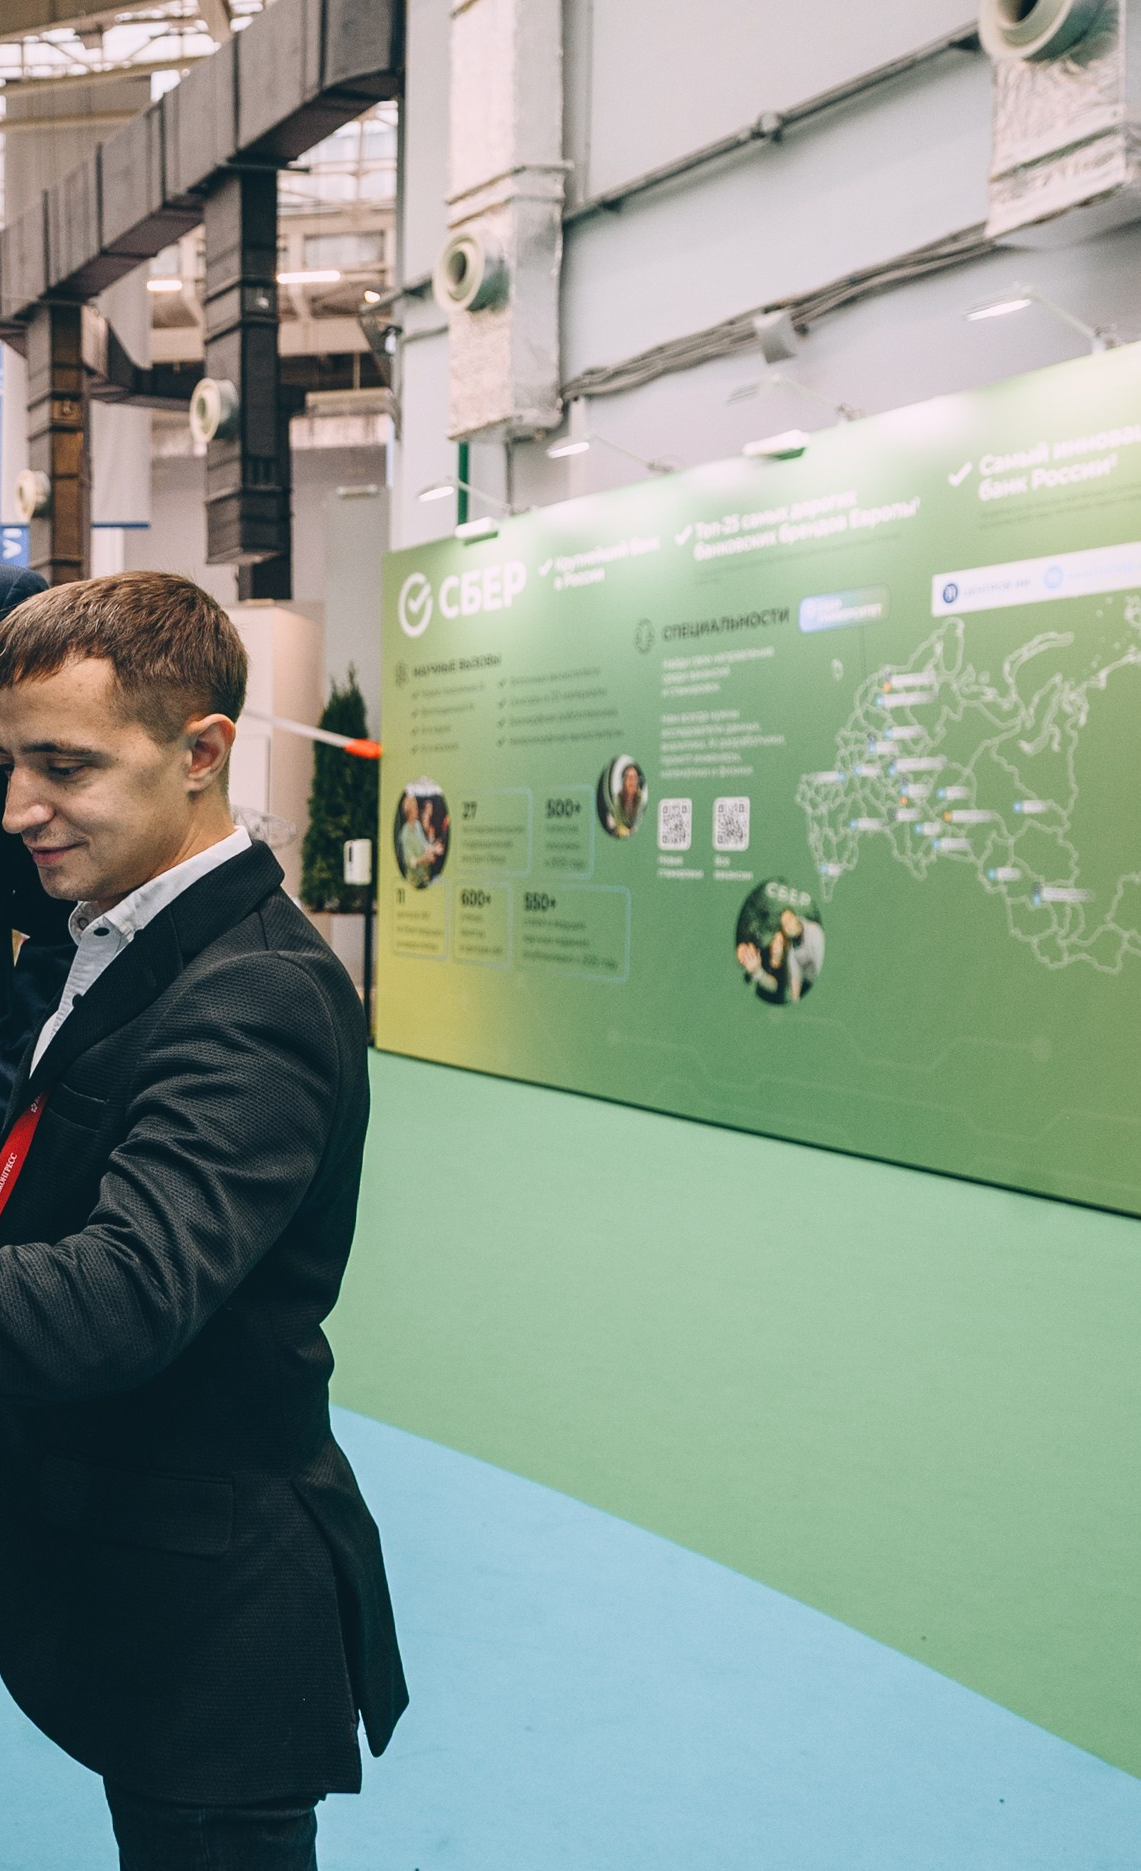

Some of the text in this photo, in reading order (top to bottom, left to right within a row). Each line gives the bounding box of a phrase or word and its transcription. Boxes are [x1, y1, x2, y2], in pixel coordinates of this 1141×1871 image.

[978, 475, 1029, 502] банк
[438, 559, 527, 620] СБЕР
[662, 606, 791, 643] СПЕЦИАЛЬНОСТИ
[461, 800, 478, 821] 27
[545, 798, 582, 819] 500+
[460, 888, 492, 908] 600+
[764, 881, 812, 907] СБЕР
